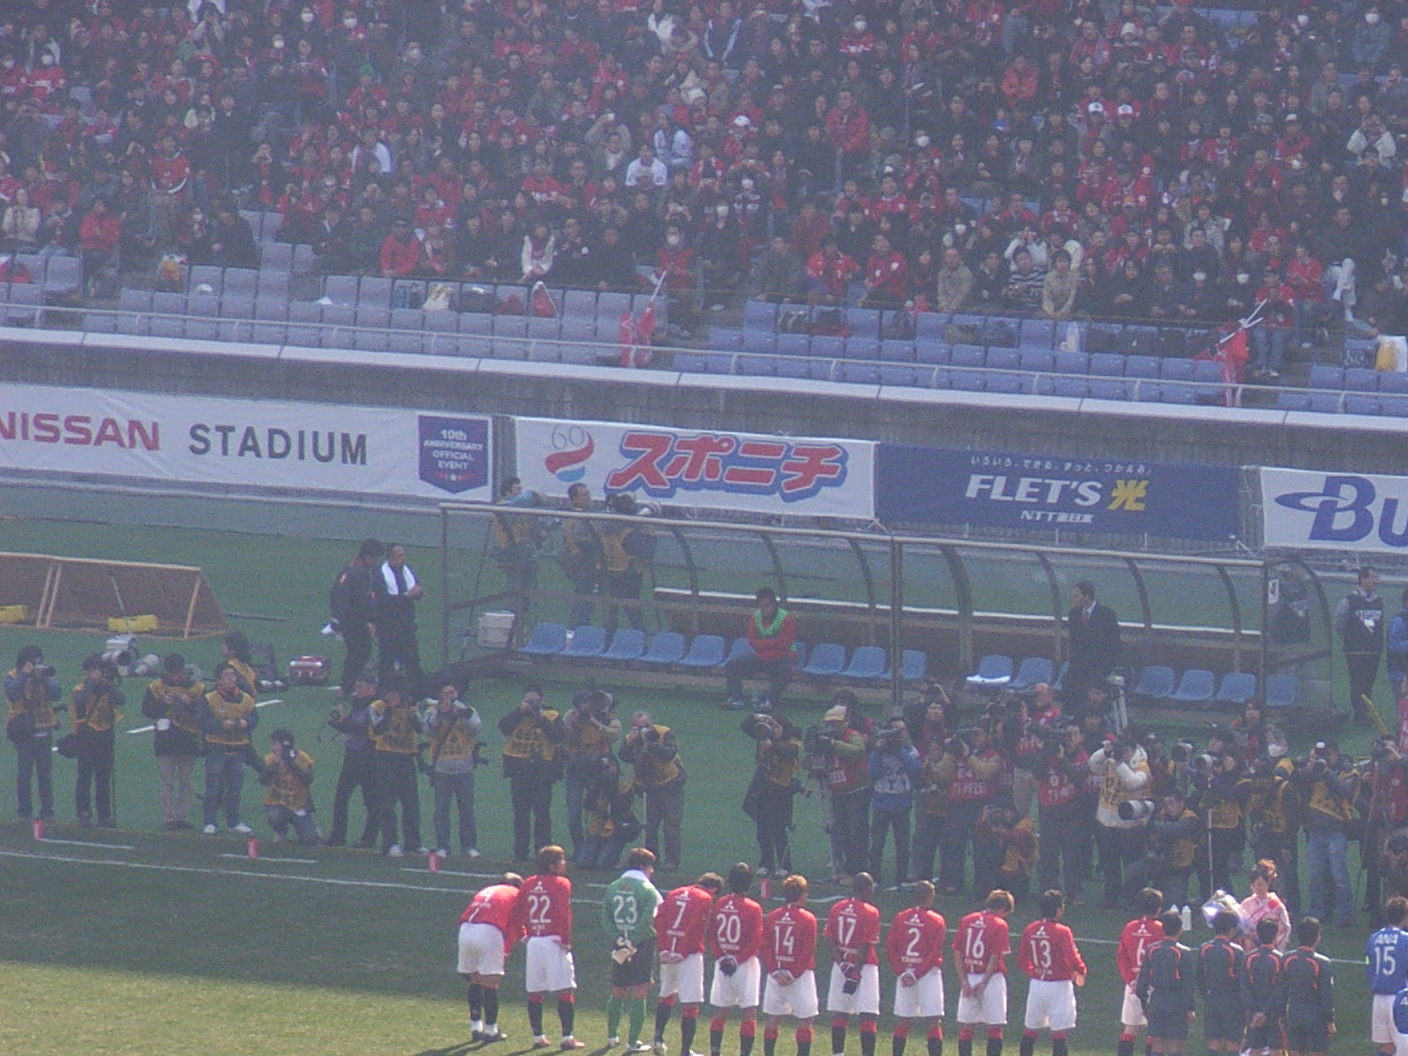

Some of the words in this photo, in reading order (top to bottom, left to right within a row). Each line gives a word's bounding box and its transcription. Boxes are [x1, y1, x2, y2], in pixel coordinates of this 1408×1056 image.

[188, 423, 367, 466] STADIUM
[440, 429, 467, 441] 10th
[432, 449, 475, 461] OFFICIAL
[438, 460, 469, 470] EVENT
[605, 431, 846, 499] スポニチ
[965, 473, 1103, 507] FLET'S
[1106, 479, 1150, 512] 光
[528, 894, 552, 923] 22
[613, 894, 638, 924] 23
[675, 900, 688, 929] 7
[716, 913, 741, 943] 20
[774, 925, 795, 955] 14
[837, 915, 858, 946] 17
[906, 927, 920, 957] 2
[965, 928, 985, 958] 16
[1374, 933, 1399, 945] ANA
[1030, 939, 1052, 969] 13
[1374, 946, 1396, 976] 15
